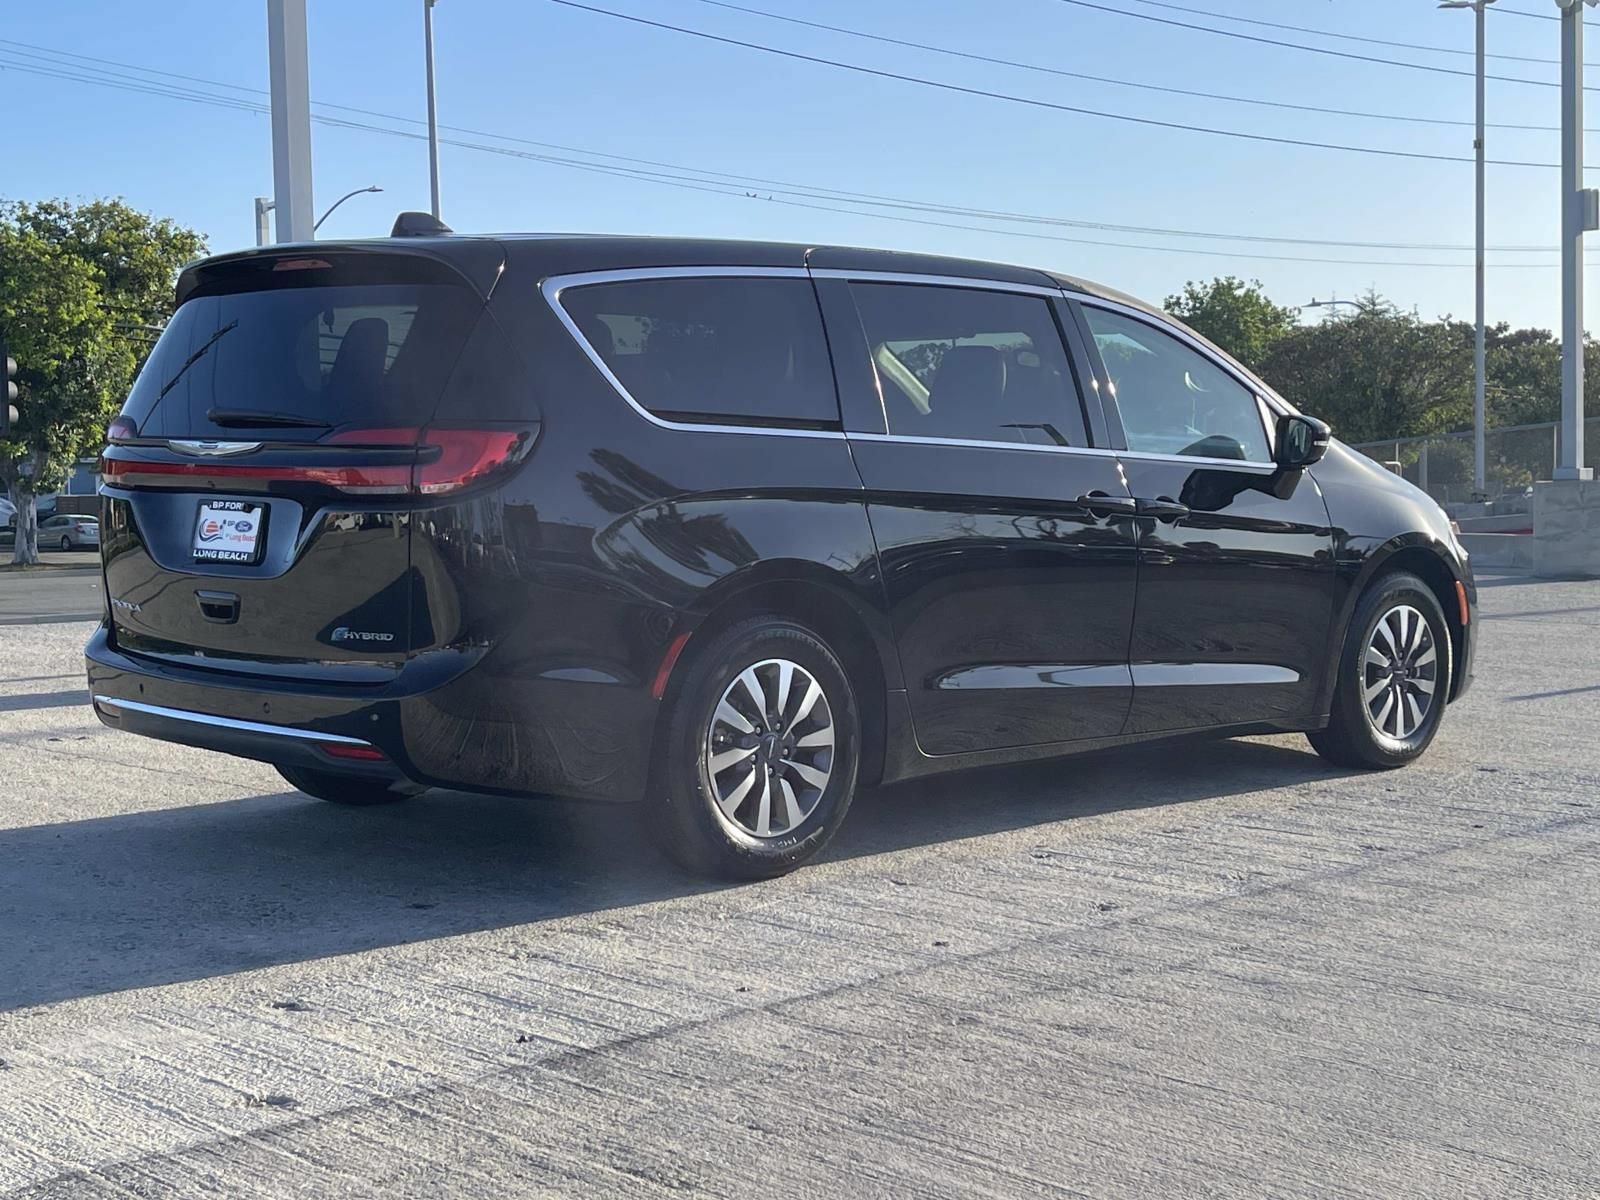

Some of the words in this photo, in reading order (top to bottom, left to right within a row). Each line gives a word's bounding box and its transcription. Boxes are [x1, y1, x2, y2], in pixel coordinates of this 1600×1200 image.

[213, 501, 224, 509] BP
[225, 502, 245, 510] FOR
[193, 548, 217, 558] LONG
[218, 552, 248, 561] BEACH
